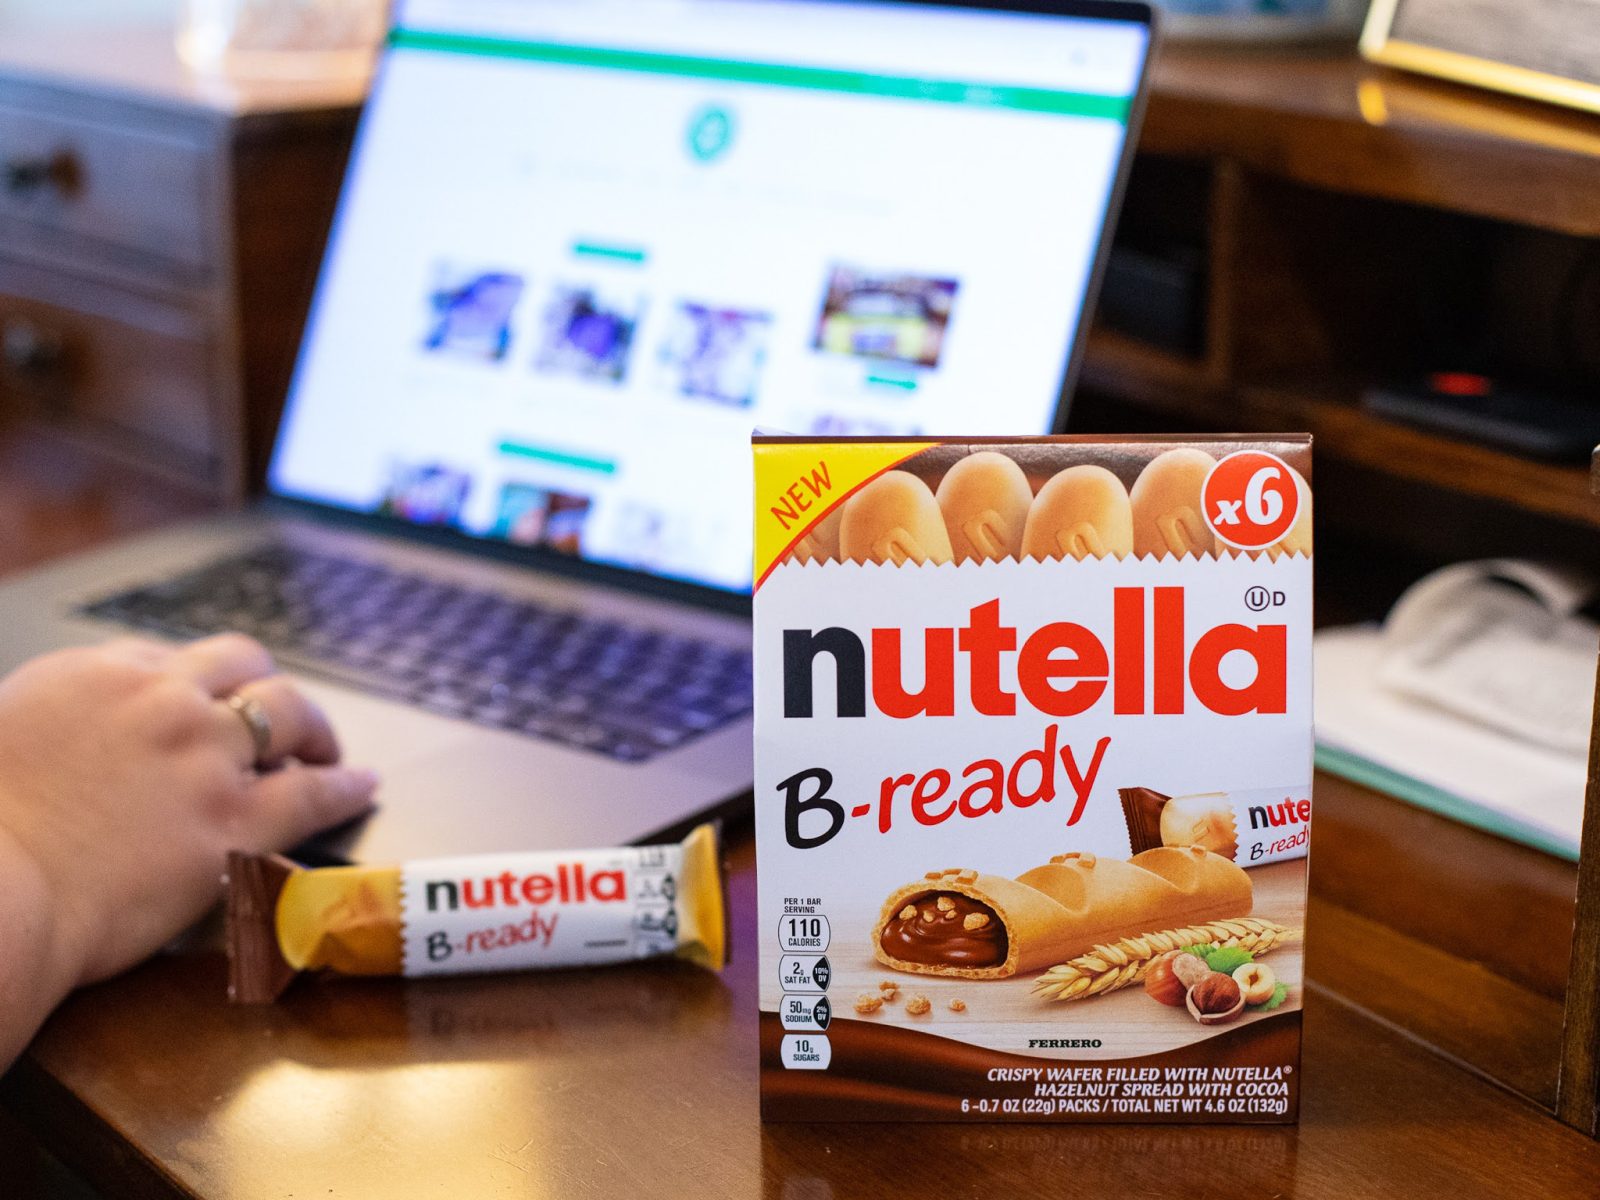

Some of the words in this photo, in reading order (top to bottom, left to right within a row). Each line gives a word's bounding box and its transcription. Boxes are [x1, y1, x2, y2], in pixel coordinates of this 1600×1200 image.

[770, 460, 832, 530] NEW
[1213, 466, 1284, 526] x6
[783, 586, 1288, 719] nutella
[776, 723, 1112, 850] B-ready
[1248, 797, 1311, 830] nute
[426, 862, 628, 912] nutella
[784, 897, 798, 906] PER
[806, 897, 821, 906] BAR
[784, 906, 815, 914] SERVING
[788, 918, 821, 937] 110
[426, 910, 559, 963] B-ready
[788, 937, 821, 947] CALORIES
[784, 975, 797, 984] SAT
[798, 976, 811, 984] FAT
[817, 974, 827, 982] DV
[785, 1014, 812, 1023] SODIUM
[817, 1013, 827, 1021] DV
[1028, 1039, 1102, 1048] FERRERO
[793, 1053, 820, 1062] SUGARS
[987, 1067, 1043, 1082] CRISPY
[1047, 1067, 1102, 1082] WAFER
[1106, 1067, 1160, 1081] FILLED
[1164, 1067, 1209, 1081] WITH
[1034, 1083, 1119, 1097] HAZELNUT
[1121, 1083, 1184, 1097] SPREAD
[1188, 1083, 1233, 1097] WITH
[1235, 1082, 1289, 1097] COCOA
[1002, 1098, 1020, 1113] OZ
[1022, 1098, 1056, 1116] (22g)
[1058, 1098, 1101, 1113] PACKS
[1112, 1098, 1151, 1113] TOTAL
[1154, 1098, 1179, 1113] NET
[1181, 1098, 1202, 1113] WT
[1204, 1098, 1226, 1113] 4.6
[1228, 1098, 1246, 1113] OZ
[1247, 1097, 1289, 1116] (132g)
